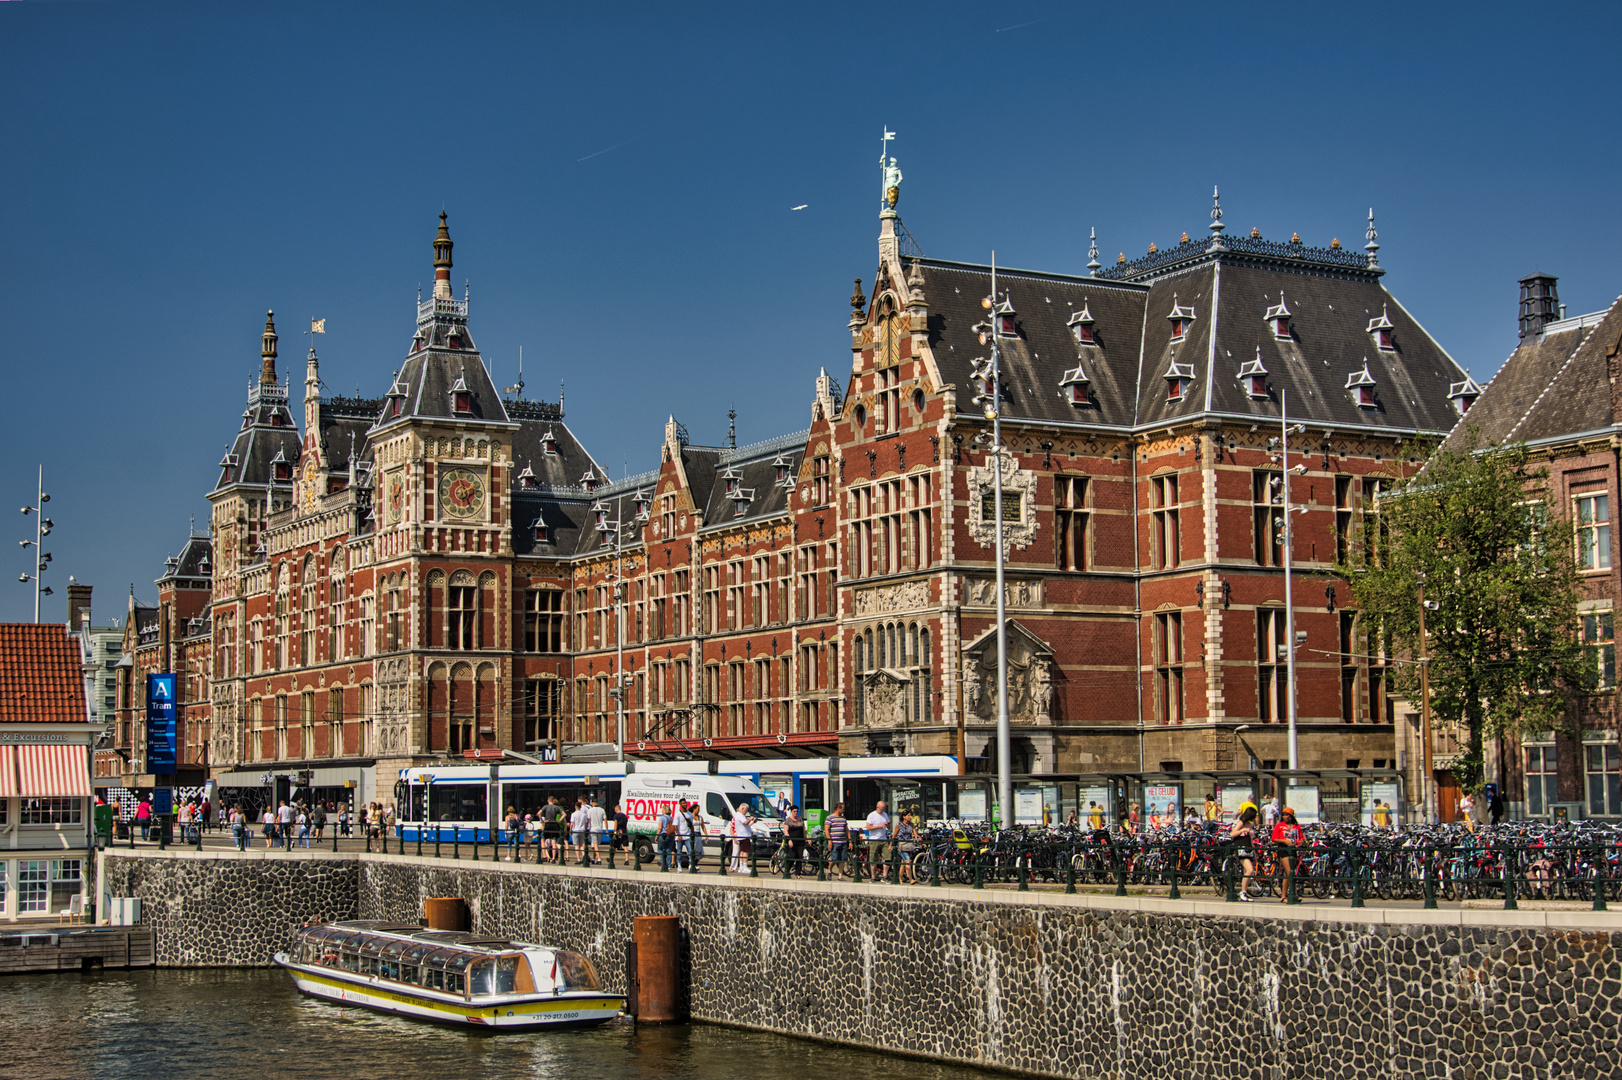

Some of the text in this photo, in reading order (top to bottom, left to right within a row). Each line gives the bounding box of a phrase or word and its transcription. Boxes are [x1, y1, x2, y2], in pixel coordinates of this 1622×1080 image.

[155, 682, 168, 696] A
[152, 702, 172, 710] Tram
[2, 732, 68, 741] & Excursions
[545, 749, 557, 761] M
[682, 792, 699, 800] Horeca
[1148, 787, 1176, 796] HET GELUID
